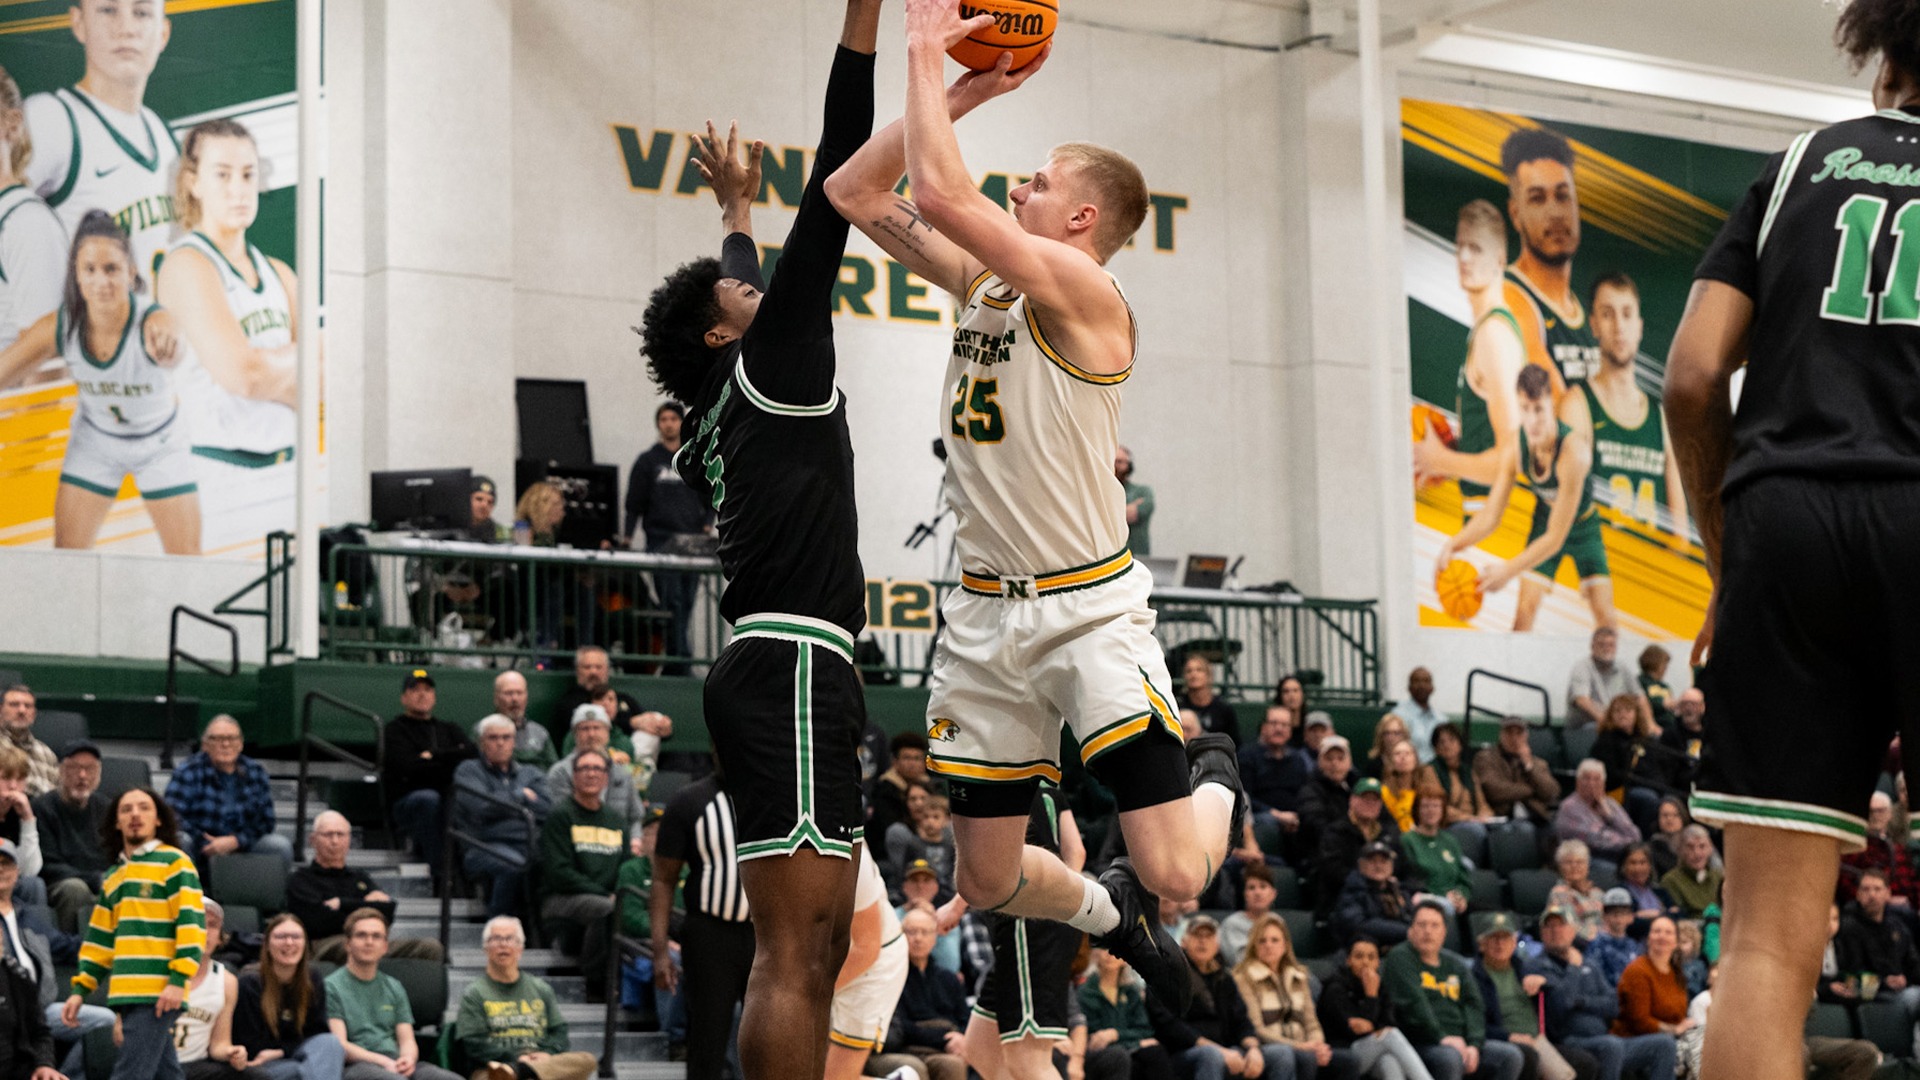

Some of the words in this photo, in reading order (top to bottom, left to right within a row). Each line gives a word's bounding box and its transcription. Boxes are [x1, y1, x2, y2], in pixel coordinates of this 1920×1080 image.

[1819, 193, 1920, 326] 11
[951, 371, 1006, 445] 25
[1006, 579, 1029, 599] N
